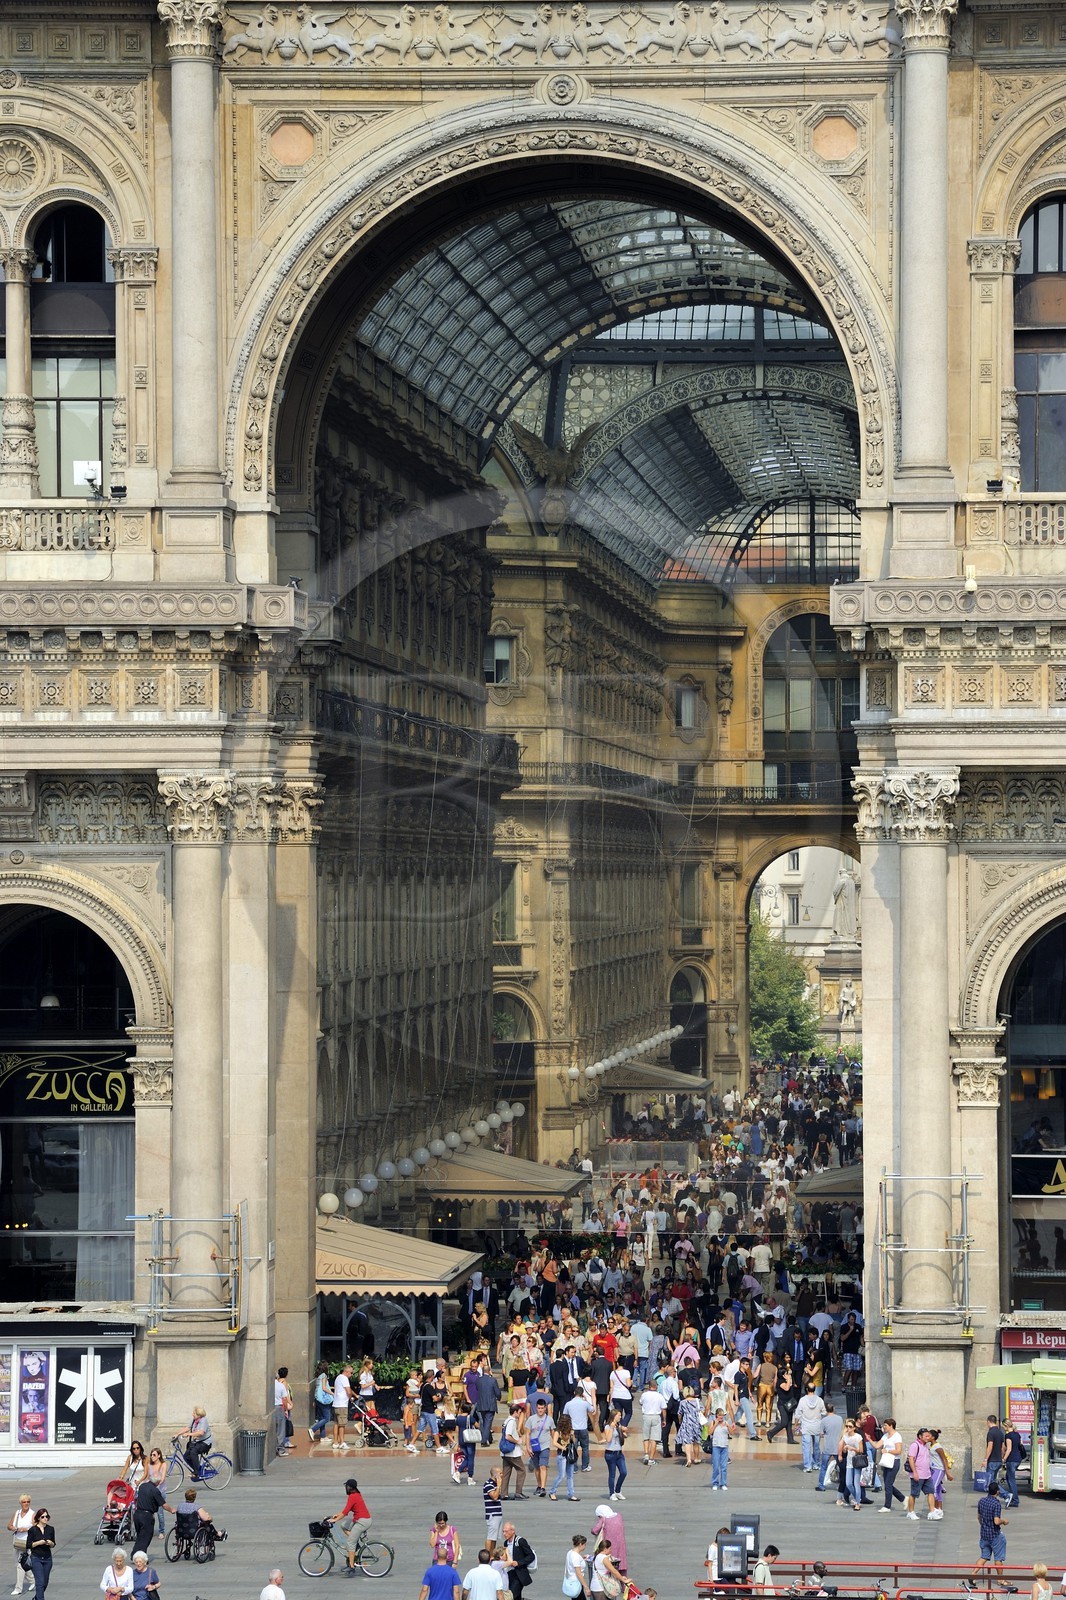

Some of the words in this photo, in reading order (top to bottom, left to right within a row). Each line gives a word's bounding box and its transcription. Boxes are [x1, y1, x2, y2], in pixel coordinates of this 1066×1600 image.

[26, 1072, 126, 1111] ZUCCA
[322, 1262, 366, 1278] ZUCCA
[1022, 1332, 1033, 1345] la
[1036, 1332, 1066, 1348] Repu
[22, 1382, 45, 1390] DAZED
